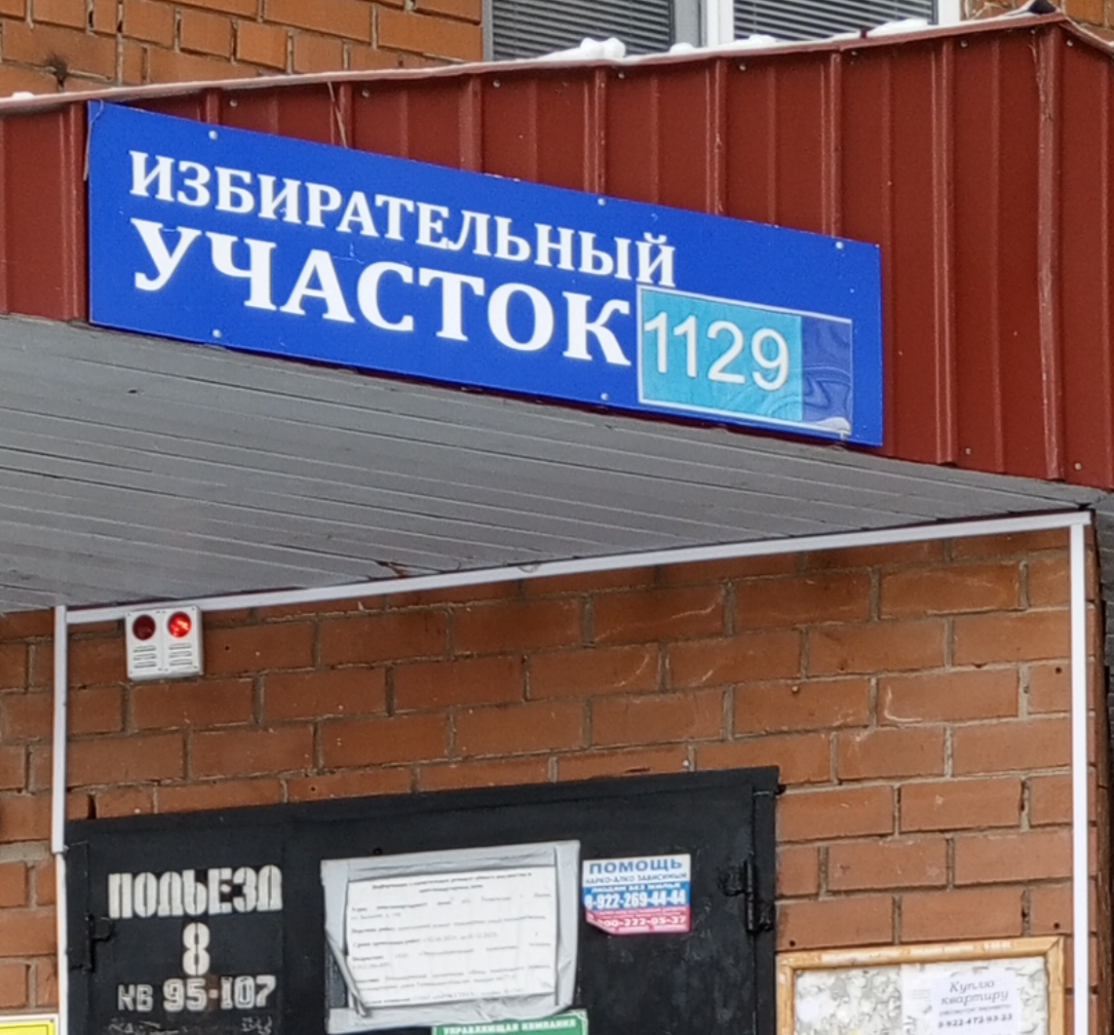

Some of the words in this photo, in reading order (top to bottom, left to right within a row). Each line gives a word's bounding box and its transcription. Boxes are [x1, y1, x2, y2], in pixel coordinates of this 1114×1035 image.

[128, 151, 676, 288] ИЗБИРАТЕЛЬНЫЙ
[130, 218, 631, 367] УЧАСТОК
[643, 311, 790, 391] 1129
[589, 859, 683, 874] ПОМОЩЬ
[182, 922, 210, 976] 8
[163, 975, 276, 1012] 95-107
[443, 1023, 519, 1035] УПРАВЛЯЮЩАЯ
[522, 1019, 577, 1031] КОМПАНИЯ
